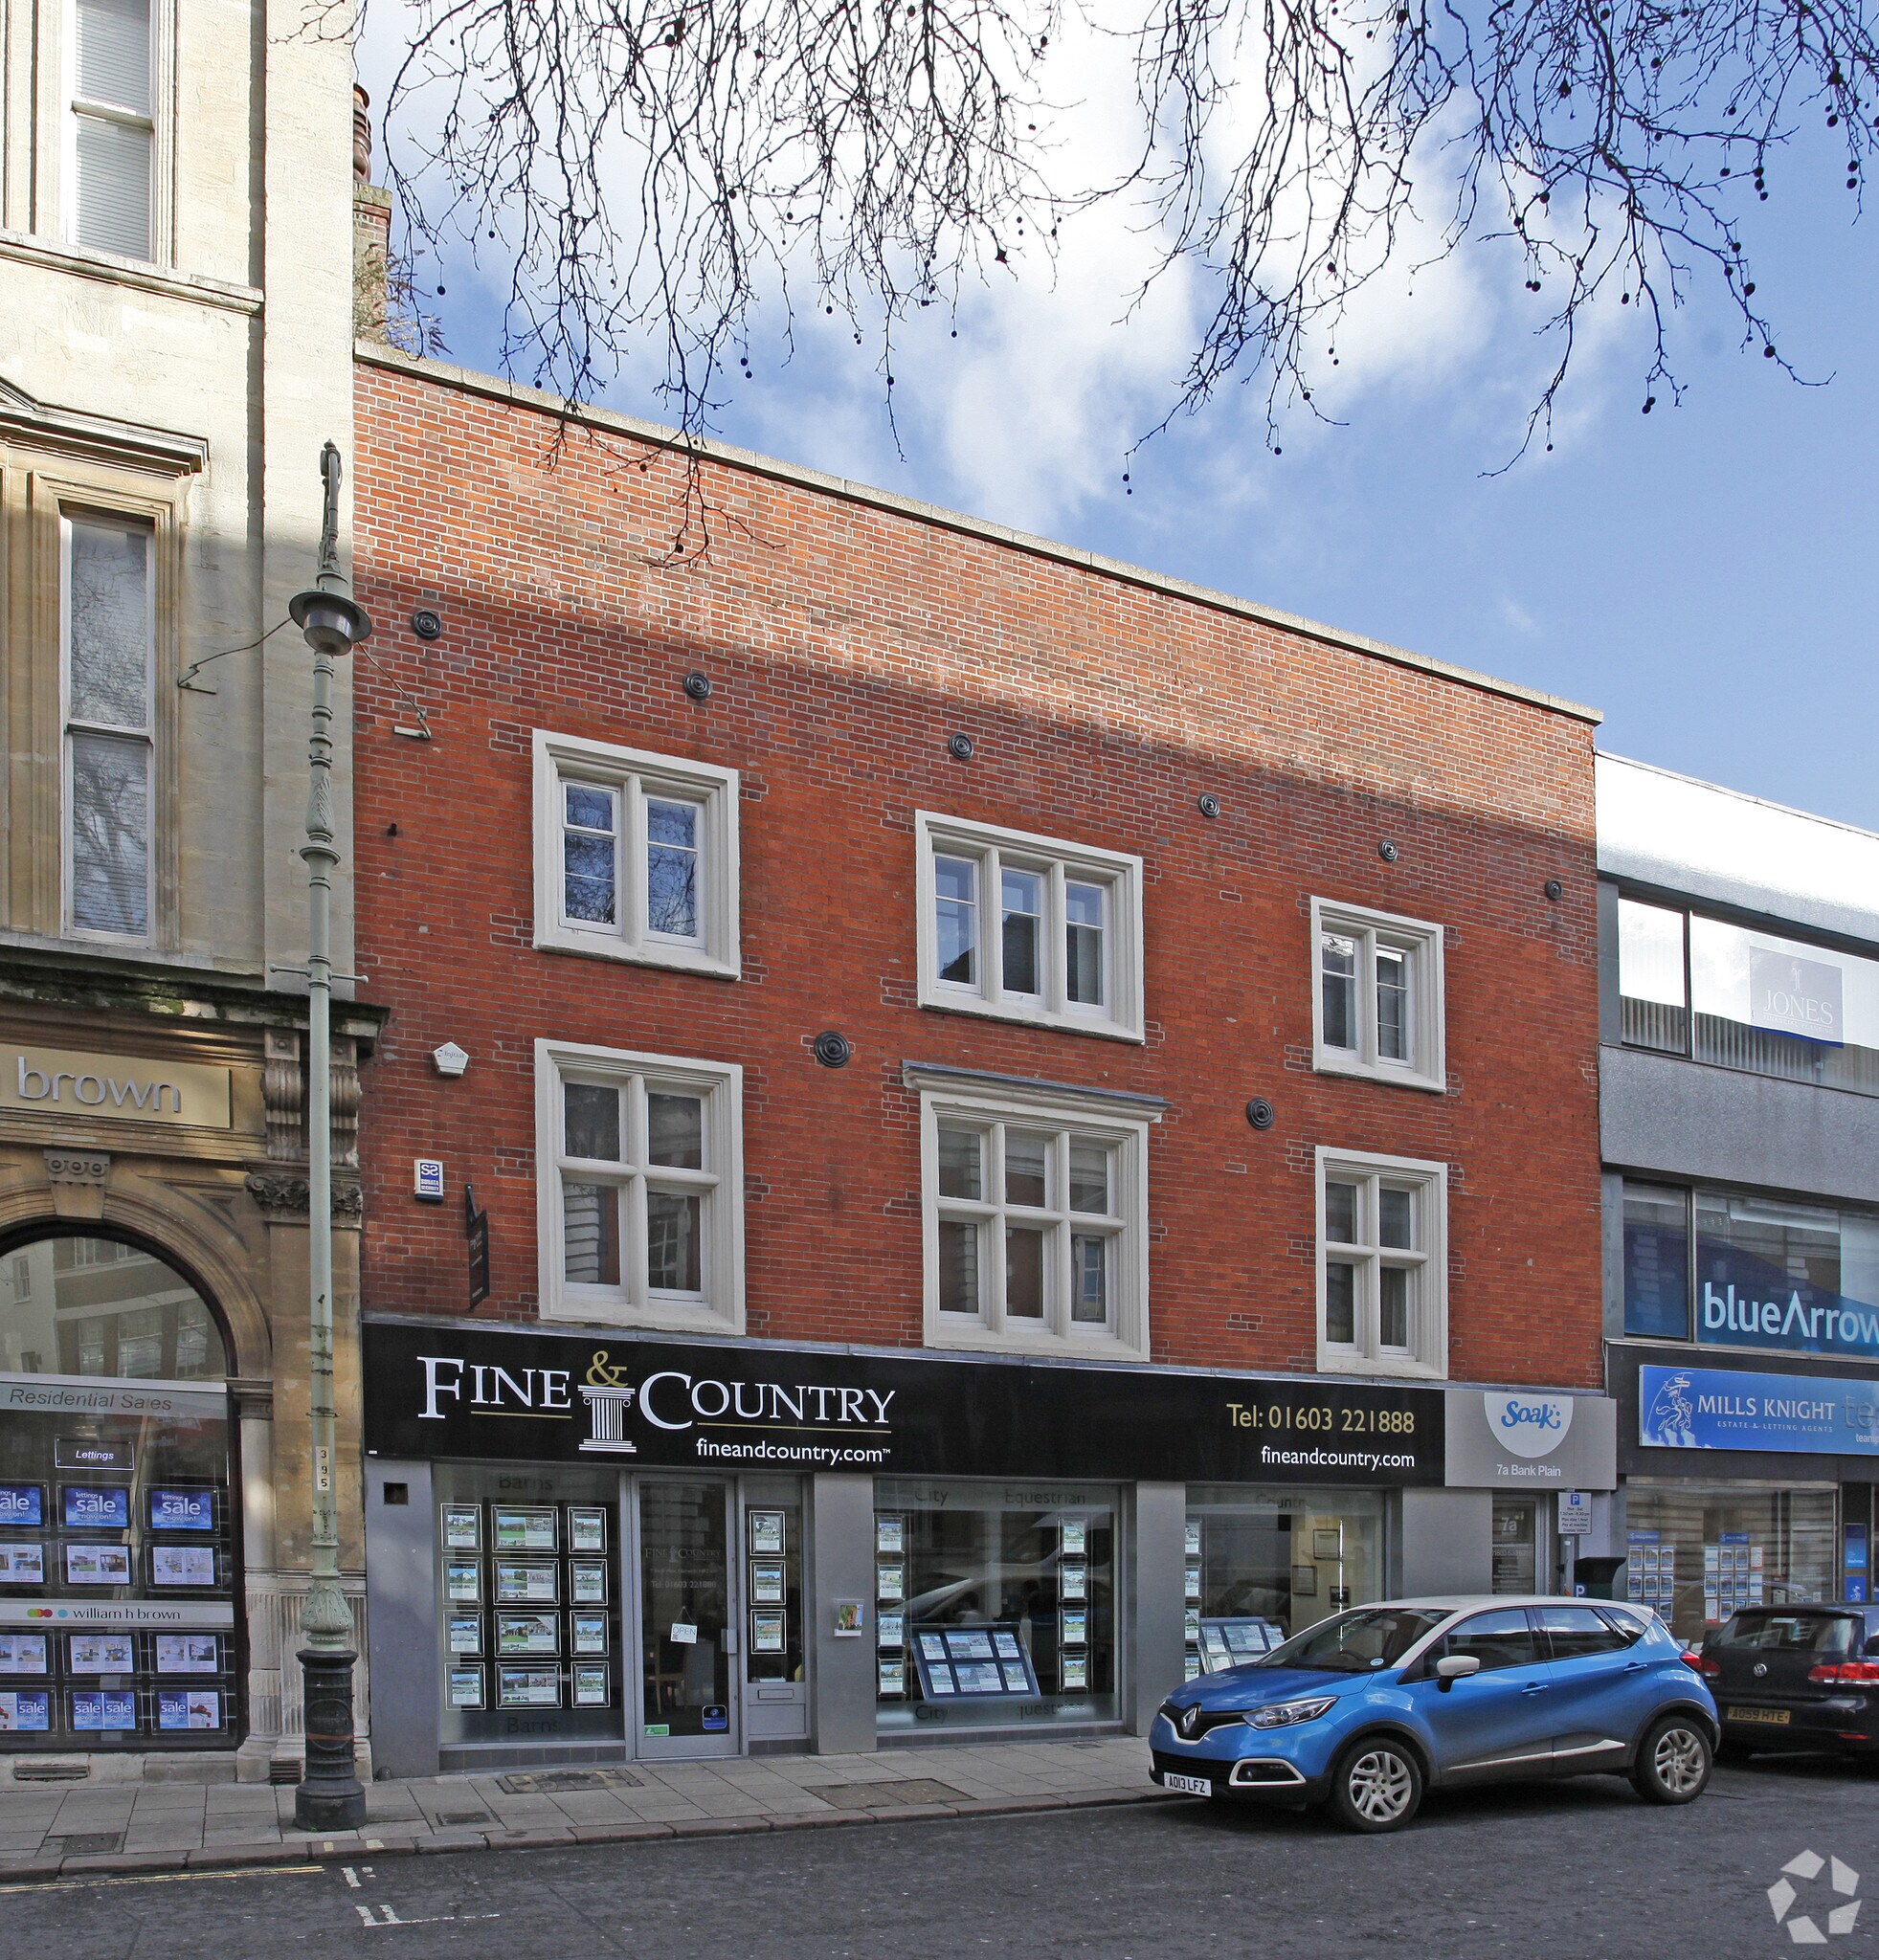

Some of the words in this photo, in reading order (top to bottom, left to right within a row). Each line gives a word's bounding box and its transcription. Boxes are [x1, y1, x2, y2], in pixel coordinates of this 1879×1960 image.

[1763, 990, 1833, 1025] JONES
[17, 1056, 181, 1112] brown
[1704, 1281, 1879, 1344] blueArrow
[416, 1355, 571, 1419] FINE
[586, 1350, 629, 1388] &
[638, 1371, 896, 1430] COUNTRY
[9, 1389, 115, 1408] Residential
[121, 1393, 172, 1411] Sales
[1697, 1394, 1757, 1416] MILLS
[1763, 1398, 1836, 1420] KNIGHT
[1226, 1403, 1264, 1428] Tel:
[1268, 1405, 1332, 1431] 01603
[1341, 1409, 1415, 1434] 221888
[1717, 1420, 1749, 1429] ESTATE
[76, 1450, 115, 1461] Lettings
[1261, 1445, 1415, 1471] fineandcountry.com
[1496, 1464, 1509, 1475] 7a
[1511, 1464, 1536, 1476] Bank
[1537, 1465, 1561, 1477] Plain
[0, 1493, 30, 1510] ale
[76, 1496, 116, 1513] sale
[162, 1498, 201, 1516] sale
[1005, 1489, 1086, 1508] Equestrian
[1501, 1517, 1517, 1531] 7a
[1576, 1585, 1585, 1597] P
[73, 1608, 123, 1619] william
[125, 1608, 134, 1619] h
[137, 1608, 181, 1620] brown
[672, 1626, 697, 1636] OPEN
[19, 1703, 45, 1714] sale
[75, 1702, 101, 1713] sale
[106, 1702, 132, 1713] sale
[161, 1701, 187, 1713] sale
[915, 1704, 949, 1723] City
[1761, 1710, 1785, 1722] HTE
[506, 1717, 561, 1733] Barns
[1169, 1775, 1186, 1790] AO13
[1188, 1778, 1206, 1793] LFZ
